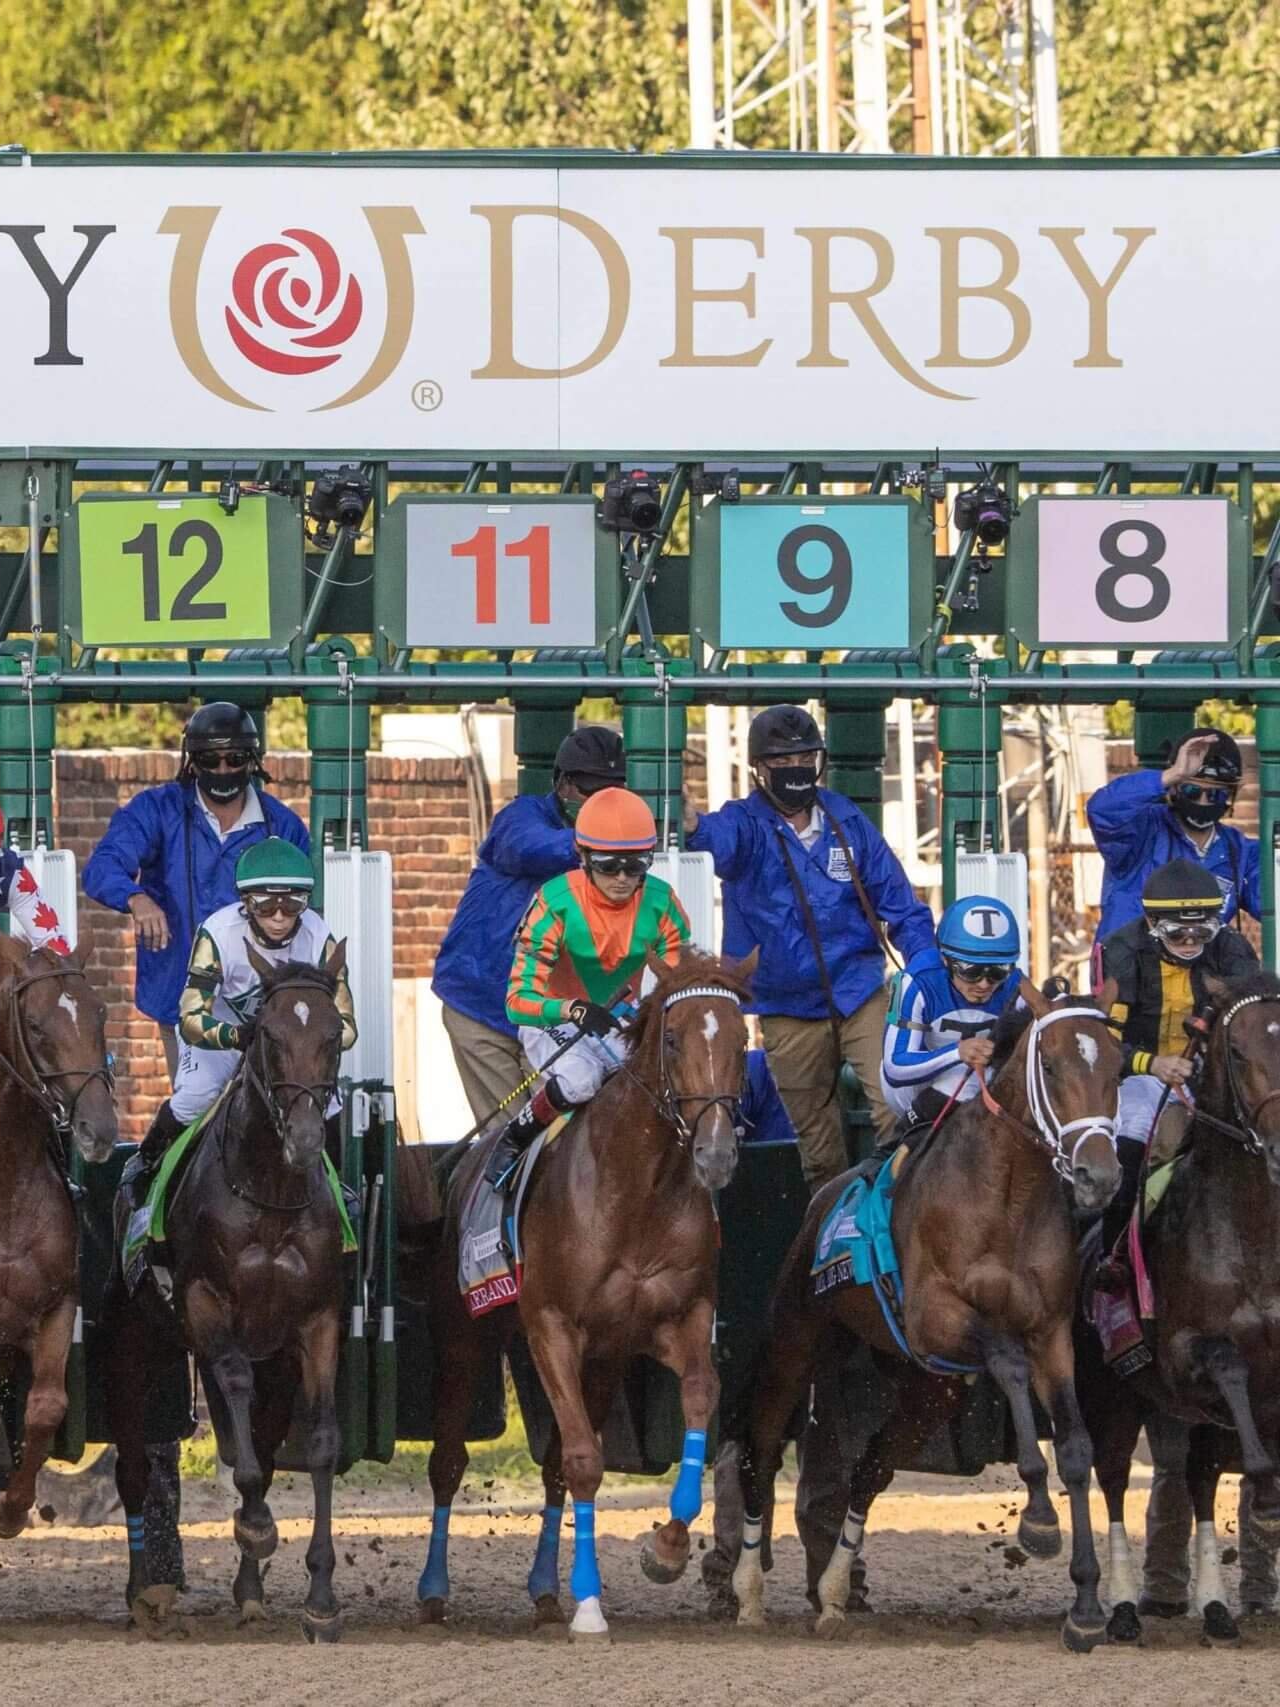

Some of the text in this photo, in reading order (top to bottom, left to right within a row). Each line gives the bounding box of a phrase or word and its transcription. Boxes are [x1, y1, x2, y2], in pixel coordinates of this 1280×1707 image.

[471, 204, 1156, 400] DERBY
[122, 520, 227, 622] 12
[451, 526, 550, 624] 11
[777, 524, 853, 628] 9
[1095, 519, 1171, 622] 8
[970, 908, 1001, 938] T
